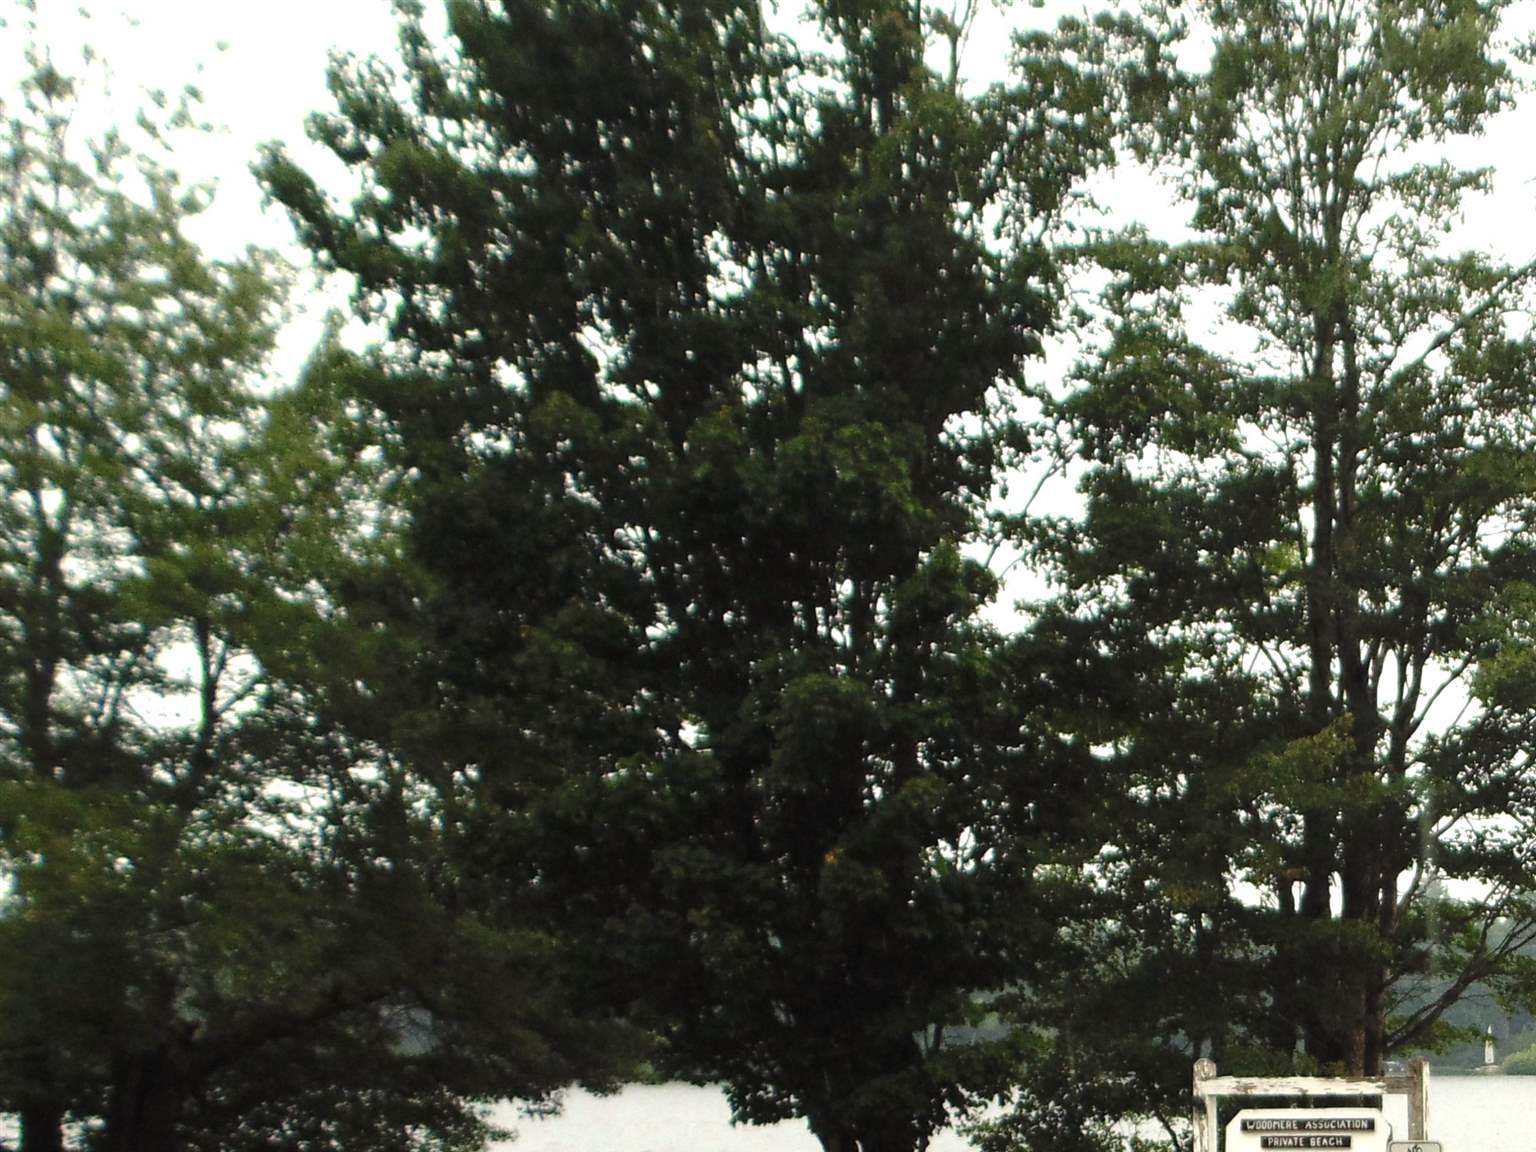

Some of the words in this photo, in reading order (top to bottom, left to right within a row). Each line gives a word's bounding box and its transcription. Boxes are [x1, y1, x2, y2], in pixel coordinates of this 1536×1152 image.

[1305, 1119, 1368, 1129] ASSOCIATION
[1268, 1136, 1304, 1146] PRIVATE
[1310, 1136, 1343, 1146] BEACH
